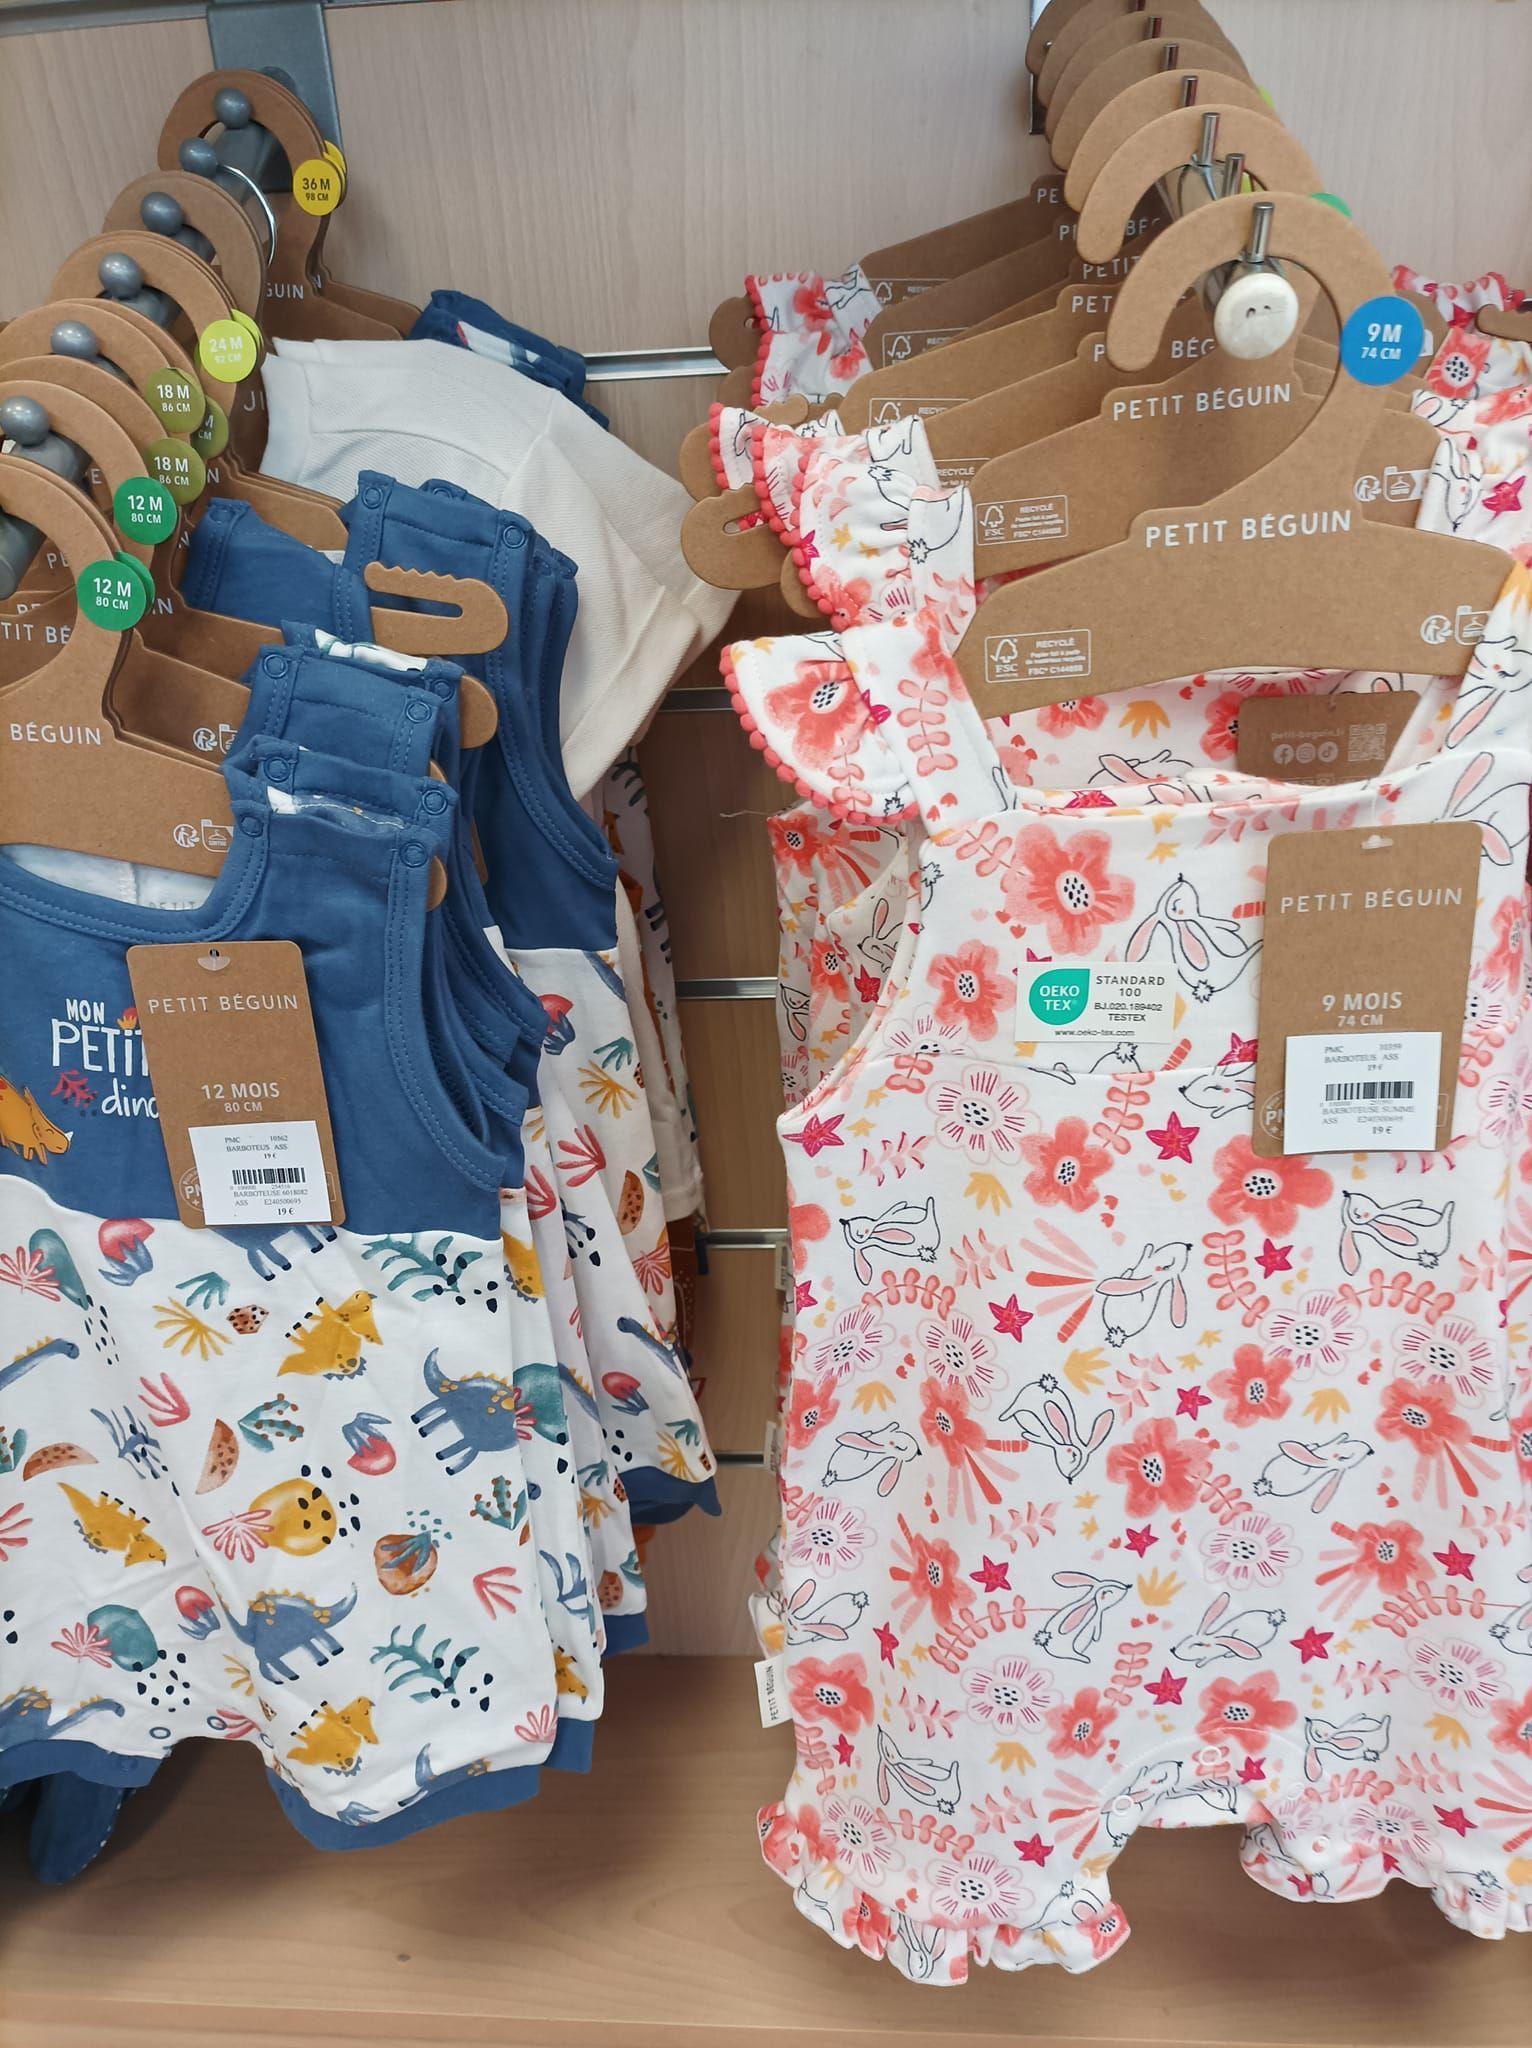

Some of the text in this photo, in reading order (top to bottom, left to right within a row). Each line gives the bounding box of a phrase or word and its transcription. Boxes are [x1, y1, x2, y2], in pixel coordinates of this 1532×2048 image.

[302, 177, 330, 191] 36 M
[316, 192, 329, 201] CM
[208, 335, 243, 353] 24 M
[227, 353, 242, 363] CM
[1361, 346, 1402, 360] 74 CM
[156, 384, 190, 400] 18 M
[161, 402, 191, 413] 86 CM
[1113, 382, 1291, 422] PETIT BÉGUIN
[154, 456, 189, 473] 18 M
[158, 475, 189, 486] 86 CM
[127, 495, 163, 511] 12 M
[131, 513, 162, 524] 80 CM
[1145, 509, 1352, 548] PETIT BÉGUIN
[93, 577, 132, 598] 12 M
[95, 596, 129, 611] 80 CM
[9, 721, 101, 746] BÉGUIN
[1280, 887, 1463, 914] PETIT BÉGUIN
[1095, 975, 1166, 986] STANDARD
[1039, 985, 1080, 997] OEKO
[1119, 987, 1142, 997] 100
[147, 993, 299, 1014] PETIT BÉGUIN
[1321, 991, 1403, 1012] 9 MOIS
[65, 998, 105, 1025] MON
[1108, 1013, 1146, 1022] TESTEX
[1337, 1013, 1384, 1027] 74 CM
[201, 1081, 280, 1100] 12 MOIS
[224, 1101, 263, 1113] 80 CM
[1372, 1126, 1393, 1134] 19 €
[277, 1207, 287, 1216] 19
